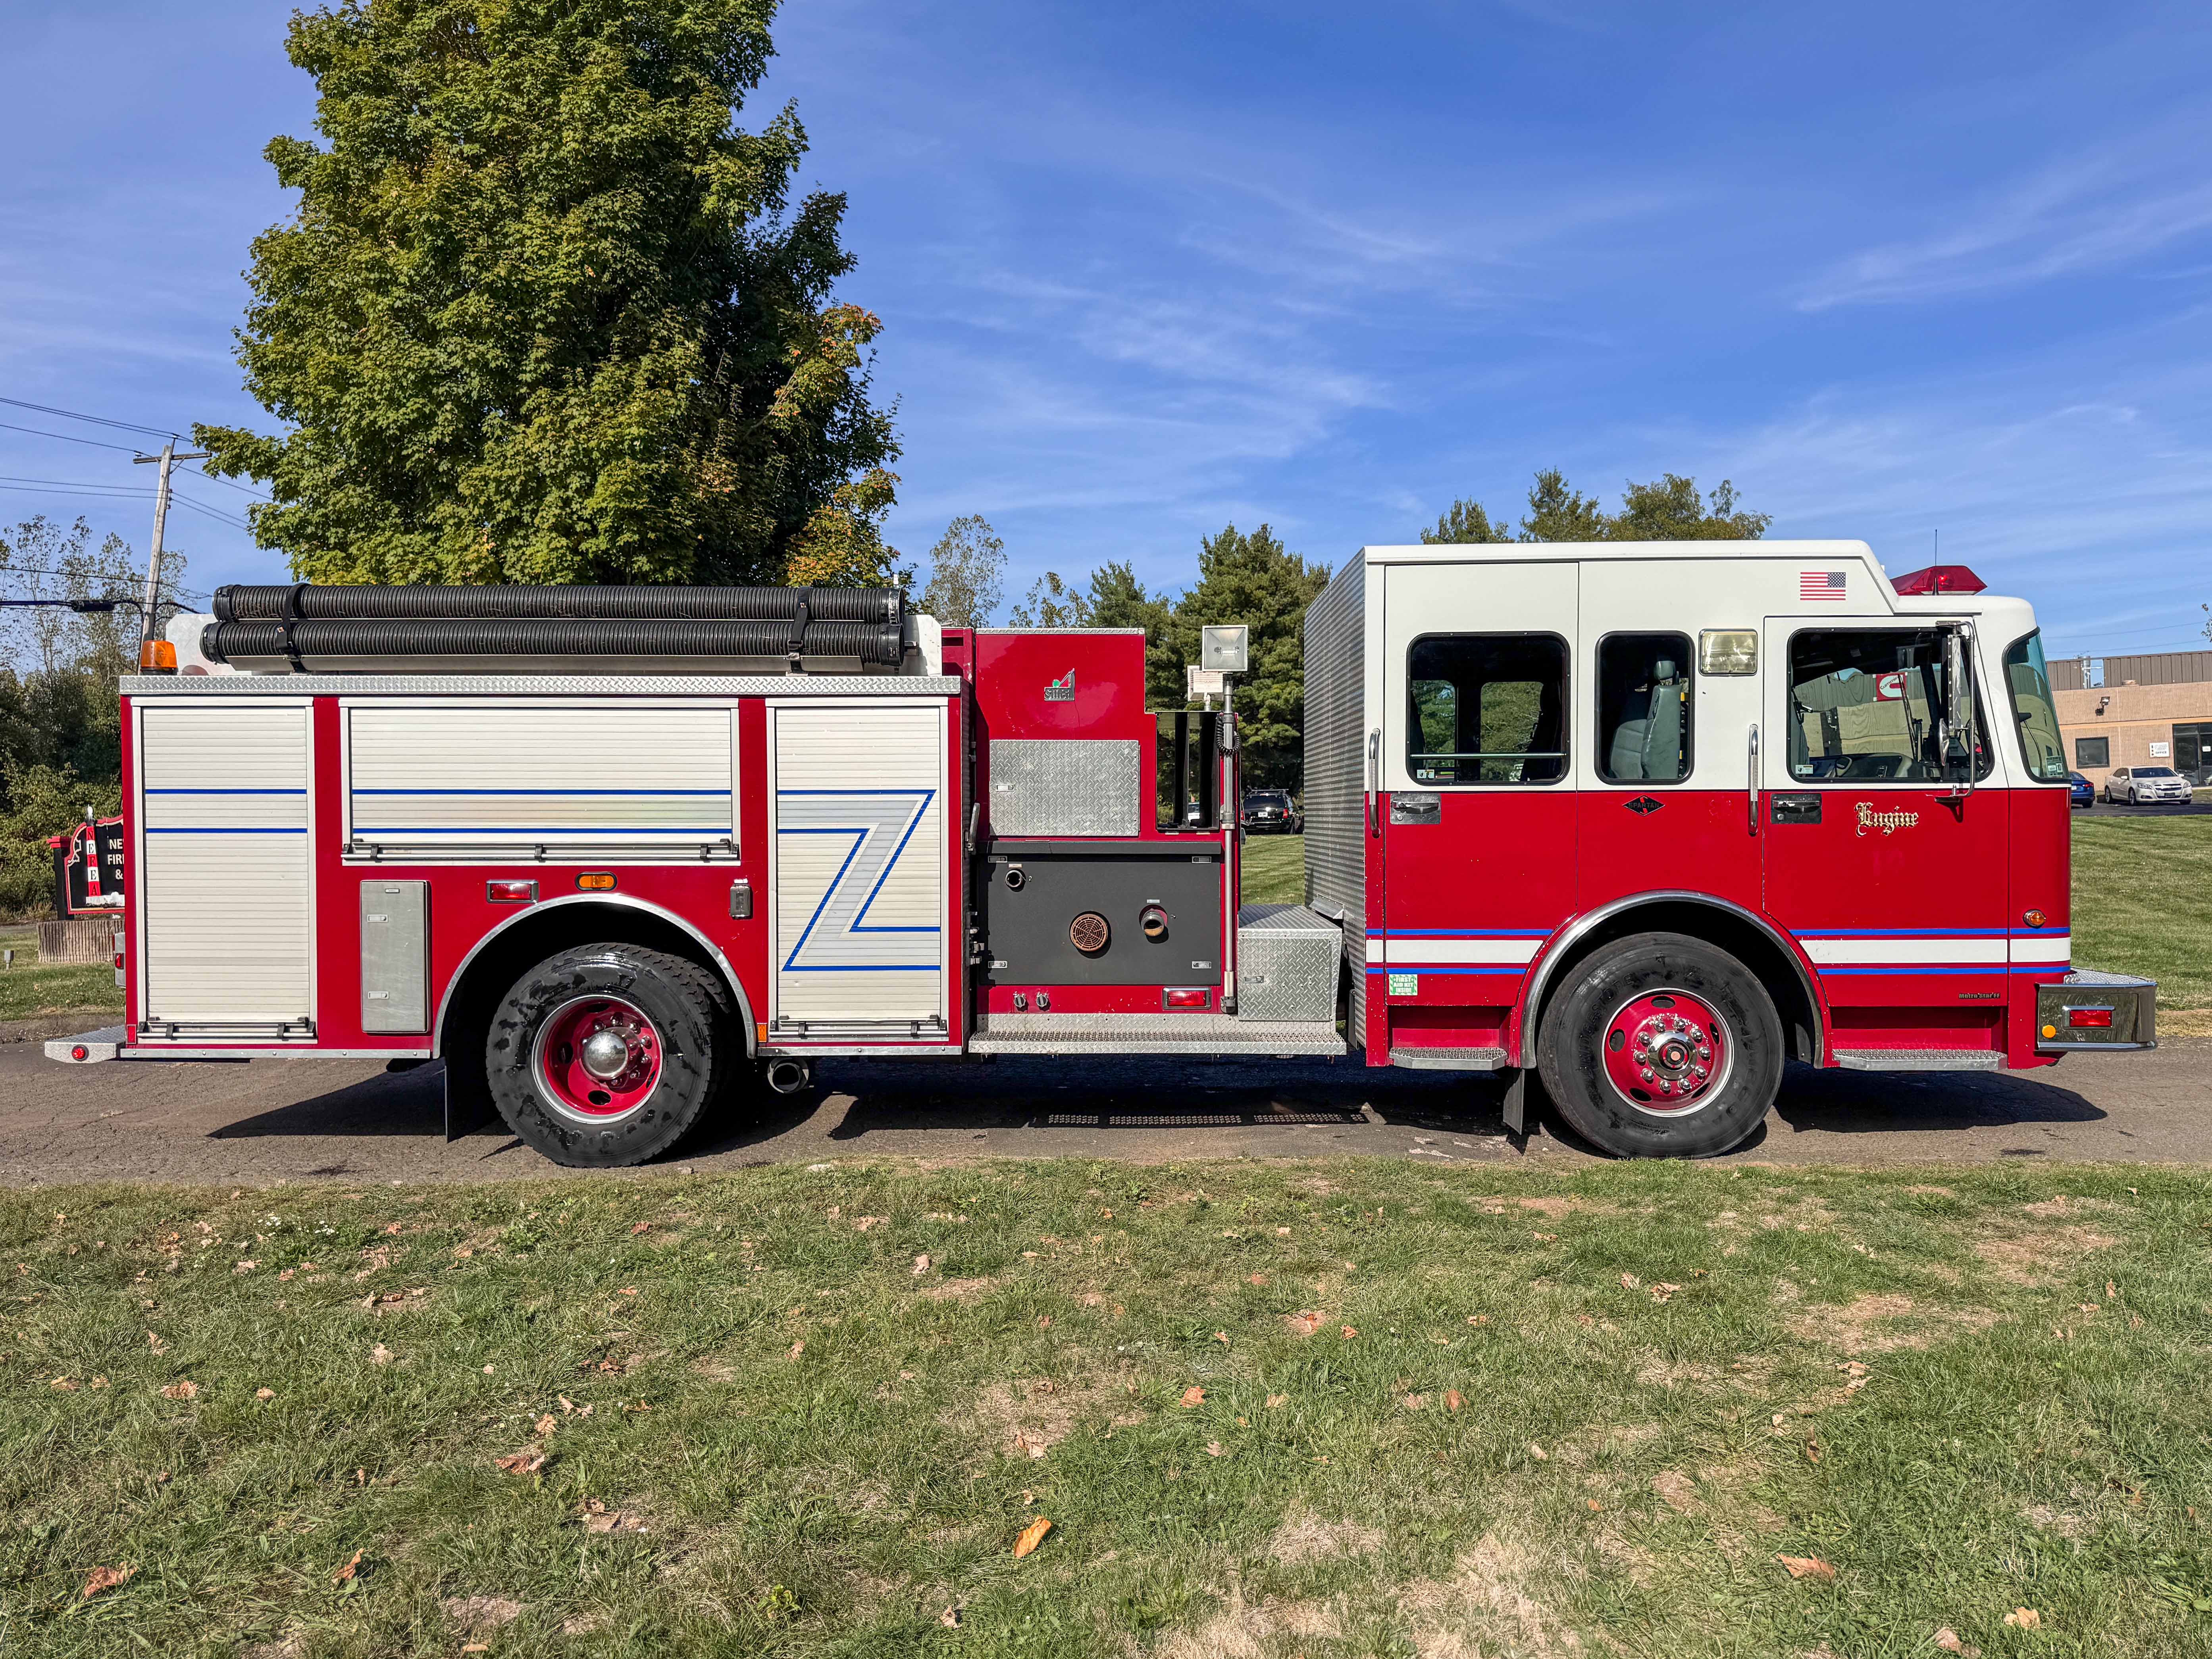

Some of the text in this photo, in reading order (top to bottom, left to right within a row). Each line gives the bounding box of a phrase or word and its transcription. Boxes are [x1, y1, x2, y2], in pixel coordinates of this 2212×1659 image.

[1854, 802, 1919, 837] Engine
[109, 839, 124, 850] NE
[108, 854, 124, 865] FIR
[116, 869, 123, 880] &
